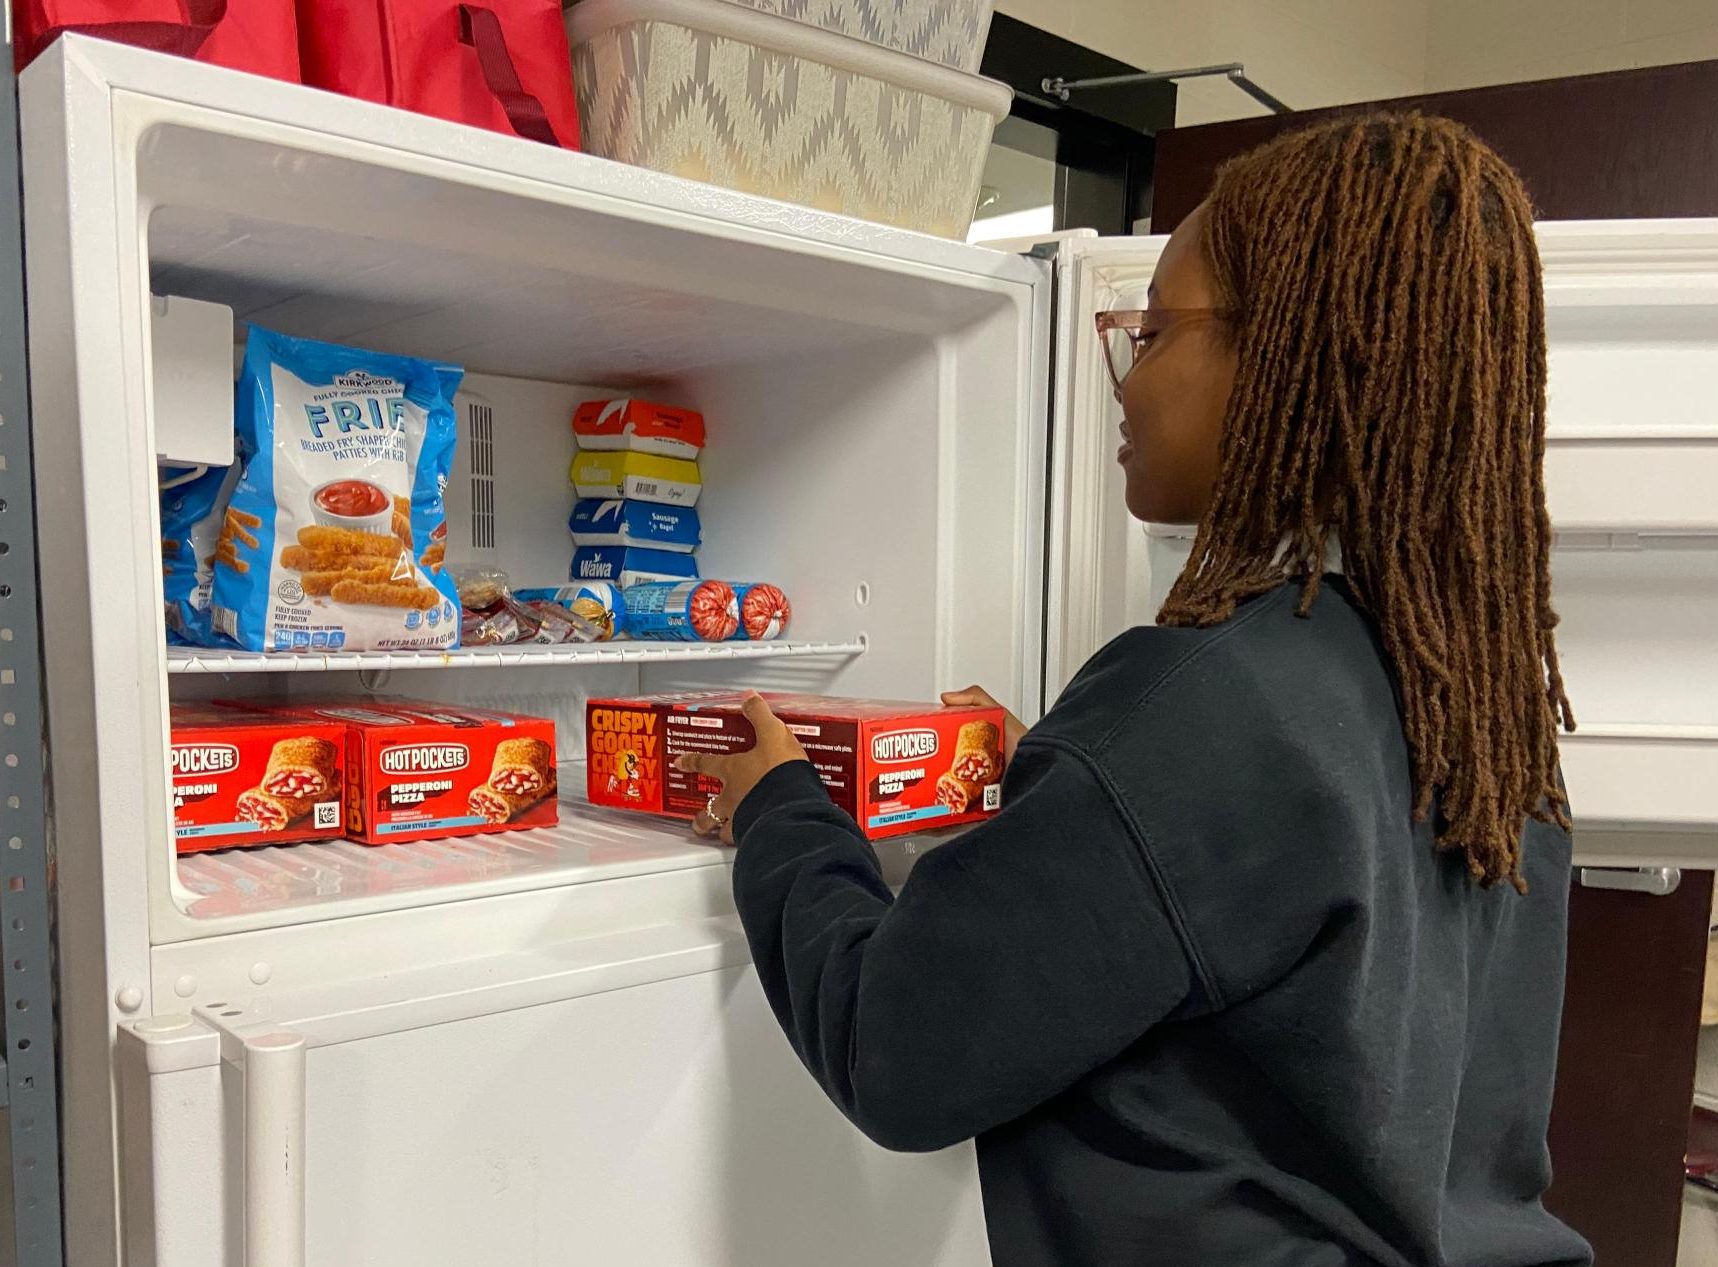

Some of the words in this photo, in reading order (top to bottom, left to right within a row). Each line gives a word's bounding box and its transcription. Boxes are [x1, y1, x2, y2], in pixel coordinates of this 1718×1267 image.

[339, 379, 392, 387] KIRKWOOD
[314, 392, 338, 402] FULLY
[337, 436, 354, 448] FRY
[333, 448, 367, 461] PATTIES
[652, 512, 679, 524] Sausage
[660, 523, 674, 532] Bagel
[580, 560, 612, 577] Wawa
[592, 709, 657, 734] CRISPY
[592, 731, 657, 758] GOOEY
[875, 736, 894, 758] HOT
[895, 733, 935, 758] POCKETS
[172, 748, 233, 772] POCKETS
[385, 749, 411, 770] HOT
[412, 747, 464, 770] POCKETS
[879, 768, 925, 784] PEPPERONI
[391, 780, 453, 794] PEPPERONI
[879, 782, 904, 795] PIZZA
[391, 792, 425, 804] PIZZA
